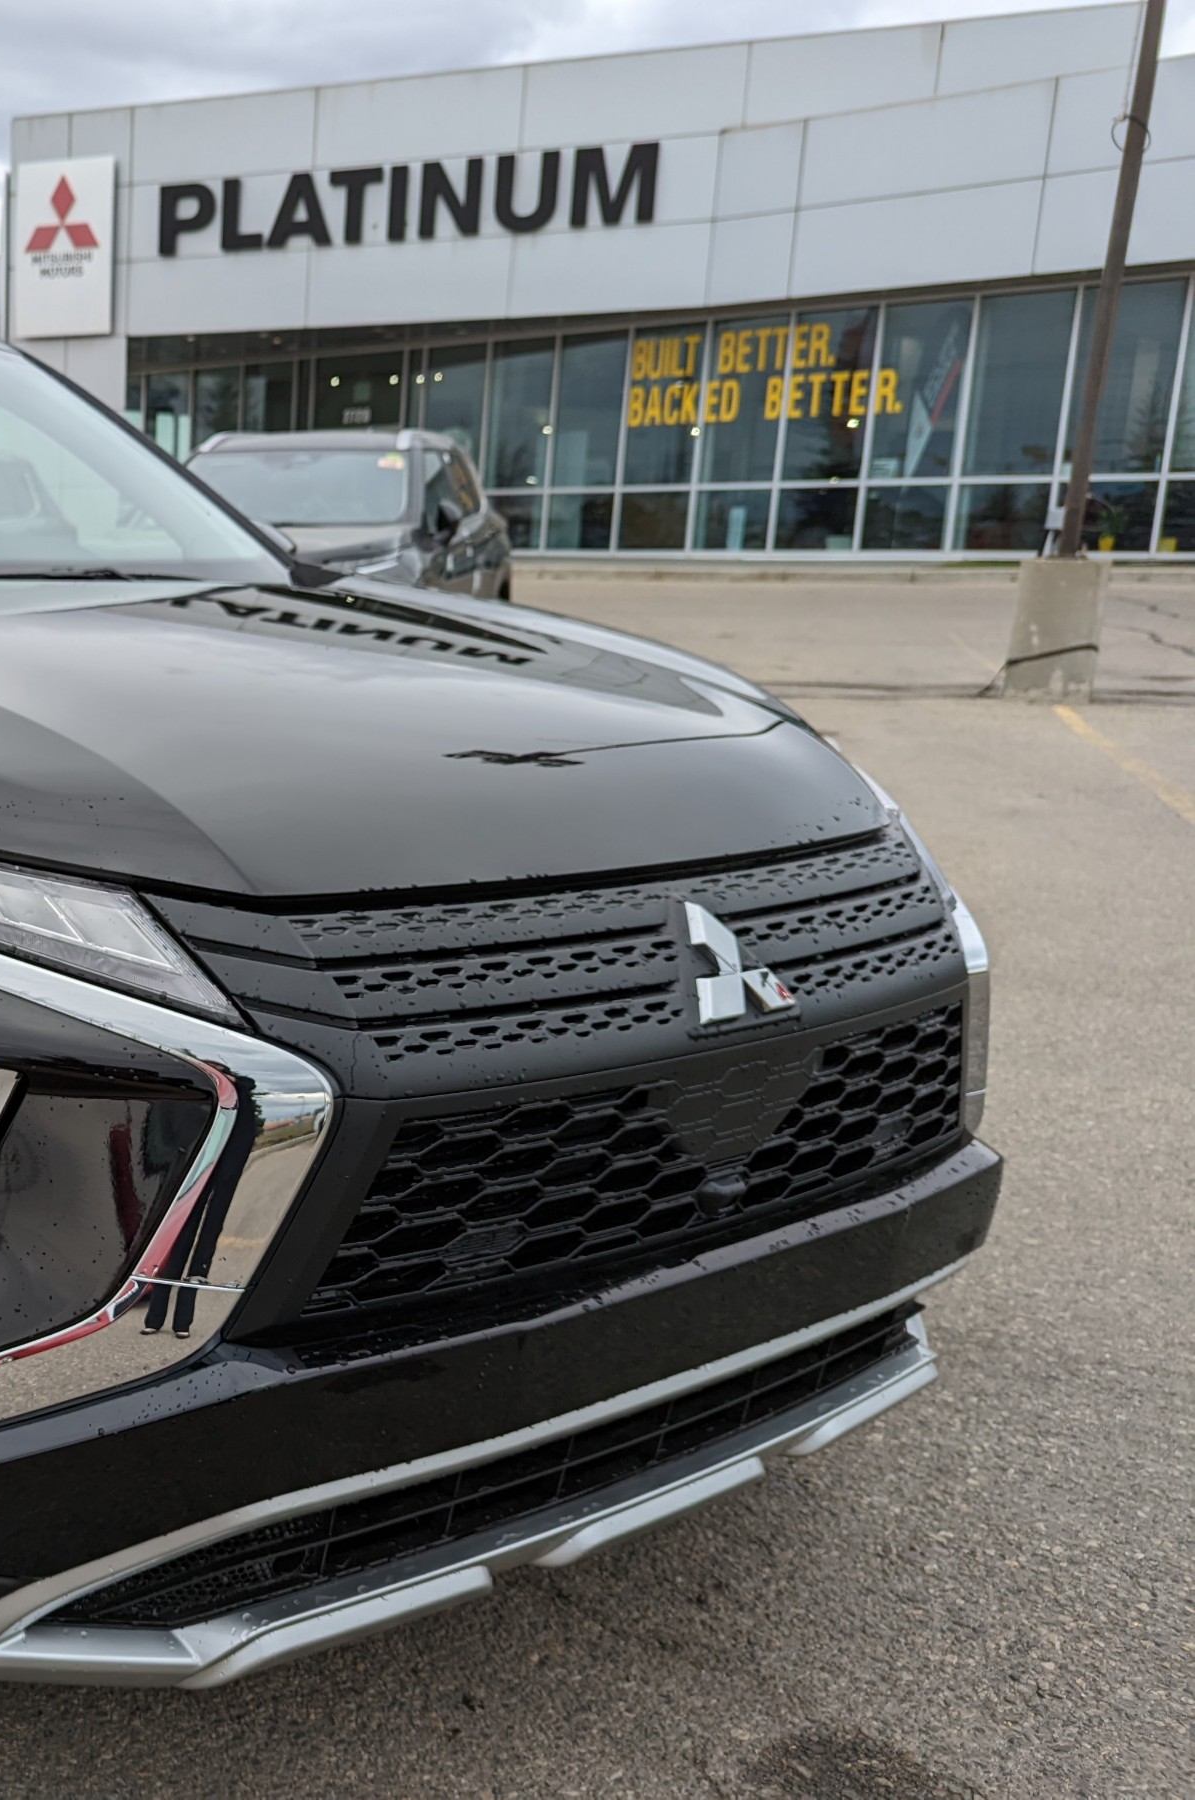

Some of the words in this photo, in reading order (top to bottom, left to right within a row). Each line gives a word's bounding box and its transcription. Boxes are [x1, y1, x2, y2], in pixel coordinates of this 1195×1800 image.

[159, 141, 661, 257] PLATINUM
[631, 333, 702, 381] BUILT
[716, 323, 837, 374] BETTER.
[627, 379, 741, 427] BACKED
[763, 368, 903, 420] BETTER.
